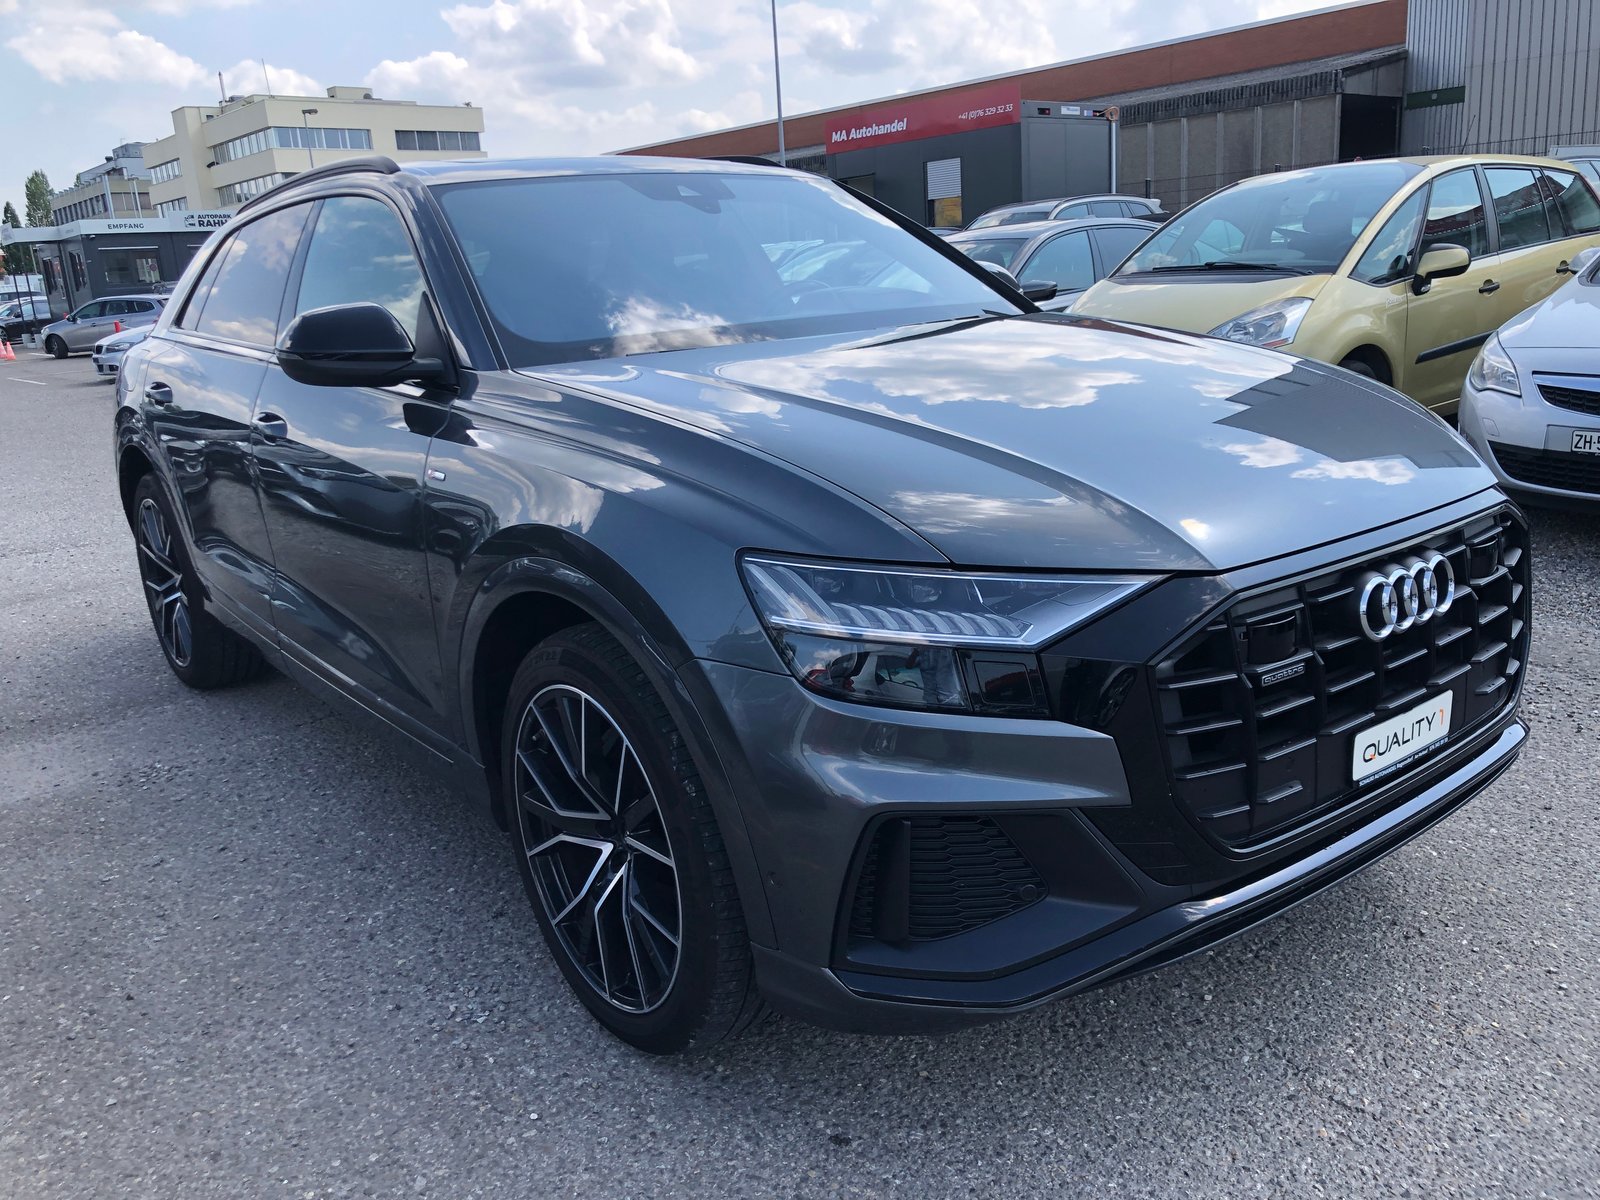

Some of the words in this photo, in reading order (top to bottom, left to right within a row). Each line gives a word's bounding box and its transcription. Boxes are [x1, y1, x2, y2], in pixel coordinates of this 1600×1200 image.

[985, 107, 996, 116] 329
[997, 105, 1005, 114] 32
[1005, 103, 1013, 112] 33
[831, 130, 847, 143] MA
[849, 118, 907, 140] Autohandel
[1264, 666, 1304, 685] quattro
[1362, 711, 1437, 763] QUALITY
[1439, 708, 1445, 726] 1
